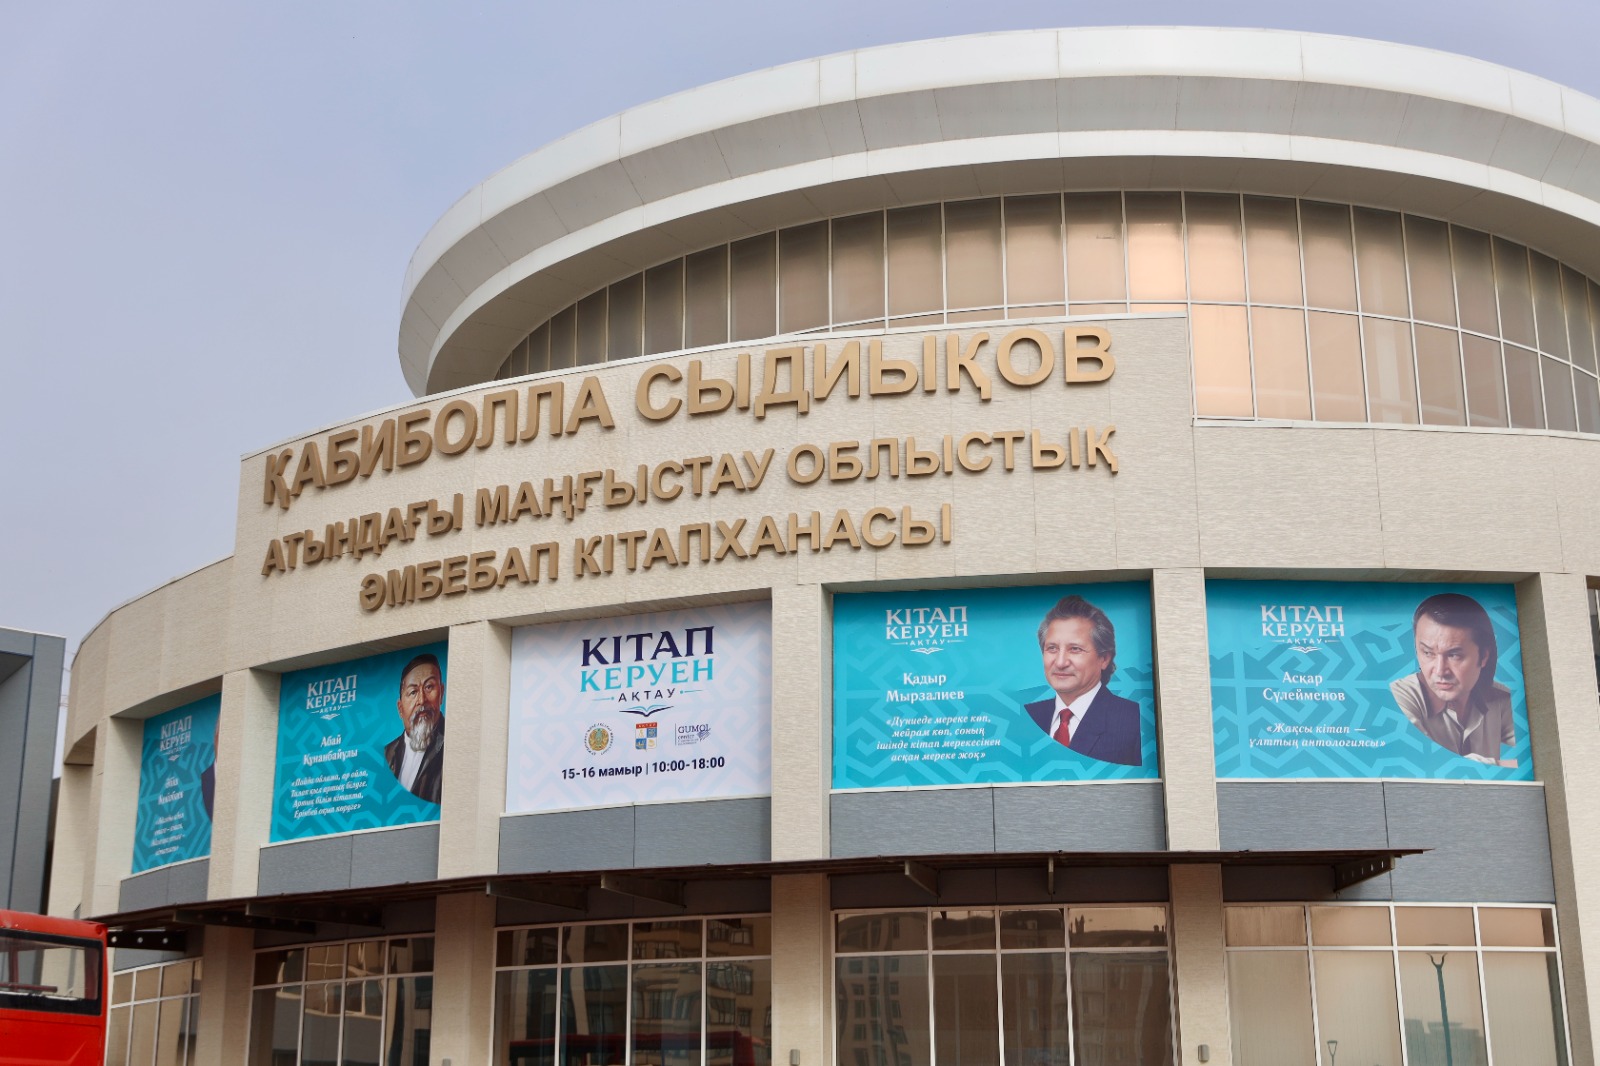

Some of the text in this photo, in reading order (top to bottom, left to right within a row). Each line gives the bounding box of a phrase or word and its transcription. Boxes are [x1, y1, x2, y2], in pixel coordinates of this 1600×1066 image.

[264, 325, 1116, 509] ҚАБИБОЛЛА СЫДИЫҚОВ
[261, 424, 1119, 576] АТЫНДАҒЫ МАҢҒЫСТАУ ОБЛЫСТЫҚ
[360, 503, 952, 611] ӘМБЕБАП КІТАПХАНАСЫ
[885, 606, 968, 625] КІТАП
[1260, 605, 1344, 622] КІТАП
[885, 623, 969, 640] КЕРУЕН
[1261, 623, 1345, 637] КЕРУЕН
[581, 626, 715, 667] КІТАП
[580, 658, 714, 692] КЕРУЕН
[903, 672, 947, 686] Қадыр
[1282, 671, 1323, 687] Асқар
[307, 675, 358, 697] КІТАП
[306, 690, 357, 710] КЕРУЕН
[618, 688, 676, 702] АҚТАУ
[886, 690, 964, 704] Мырзалиев
[1262, 687, 1346, 703] Сүлейменов
[934, 716, 968, 726] мереке
[1315, 724, 1350, 734] кітап
[320, 734, 342, 747] Абай
[892, 728, 930, 739] мейрам
[910, 739, 940, 749] кітап
[922, 752, 956, 762] мереке
[561, 767, 595, 780] 15-16
[599, 765, 642, 777] мамыр
[652, 756, 726, 773] 10:00-18:00
